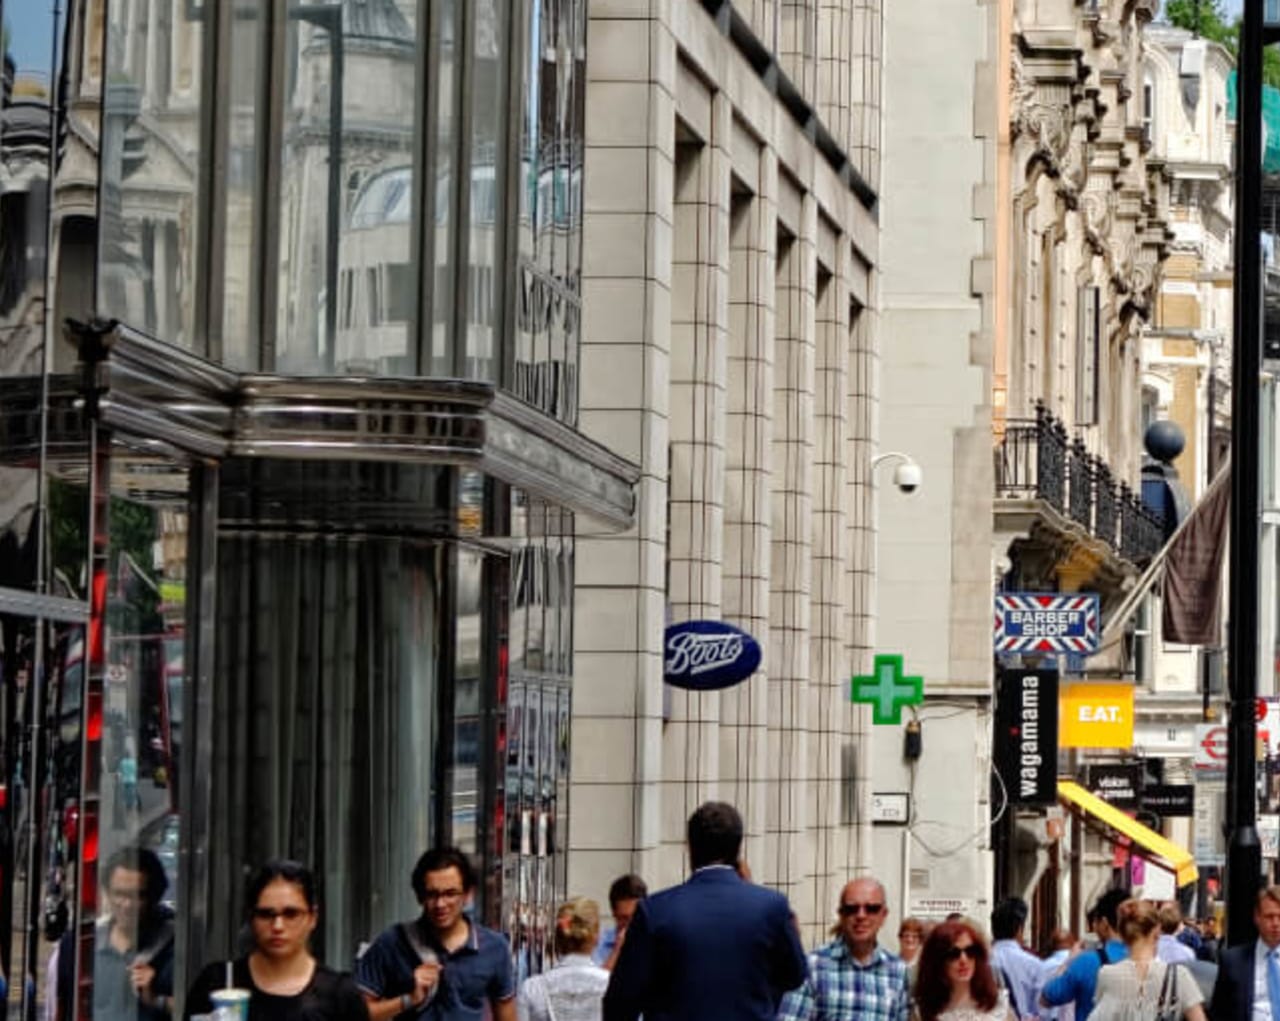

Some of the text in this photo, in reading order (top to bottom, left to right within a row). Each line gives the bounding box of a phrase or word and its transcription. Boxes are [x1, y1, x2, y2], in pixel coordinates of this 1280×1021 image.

[1011, 612, 1079, 624] BARBER
[1022, 624, 1068, 636] SHOP
[666, 632, 743, 675] Boots
[1078, 706, 1123, 723] EAT.
[1020, 676, 1042, 797] wagamama
